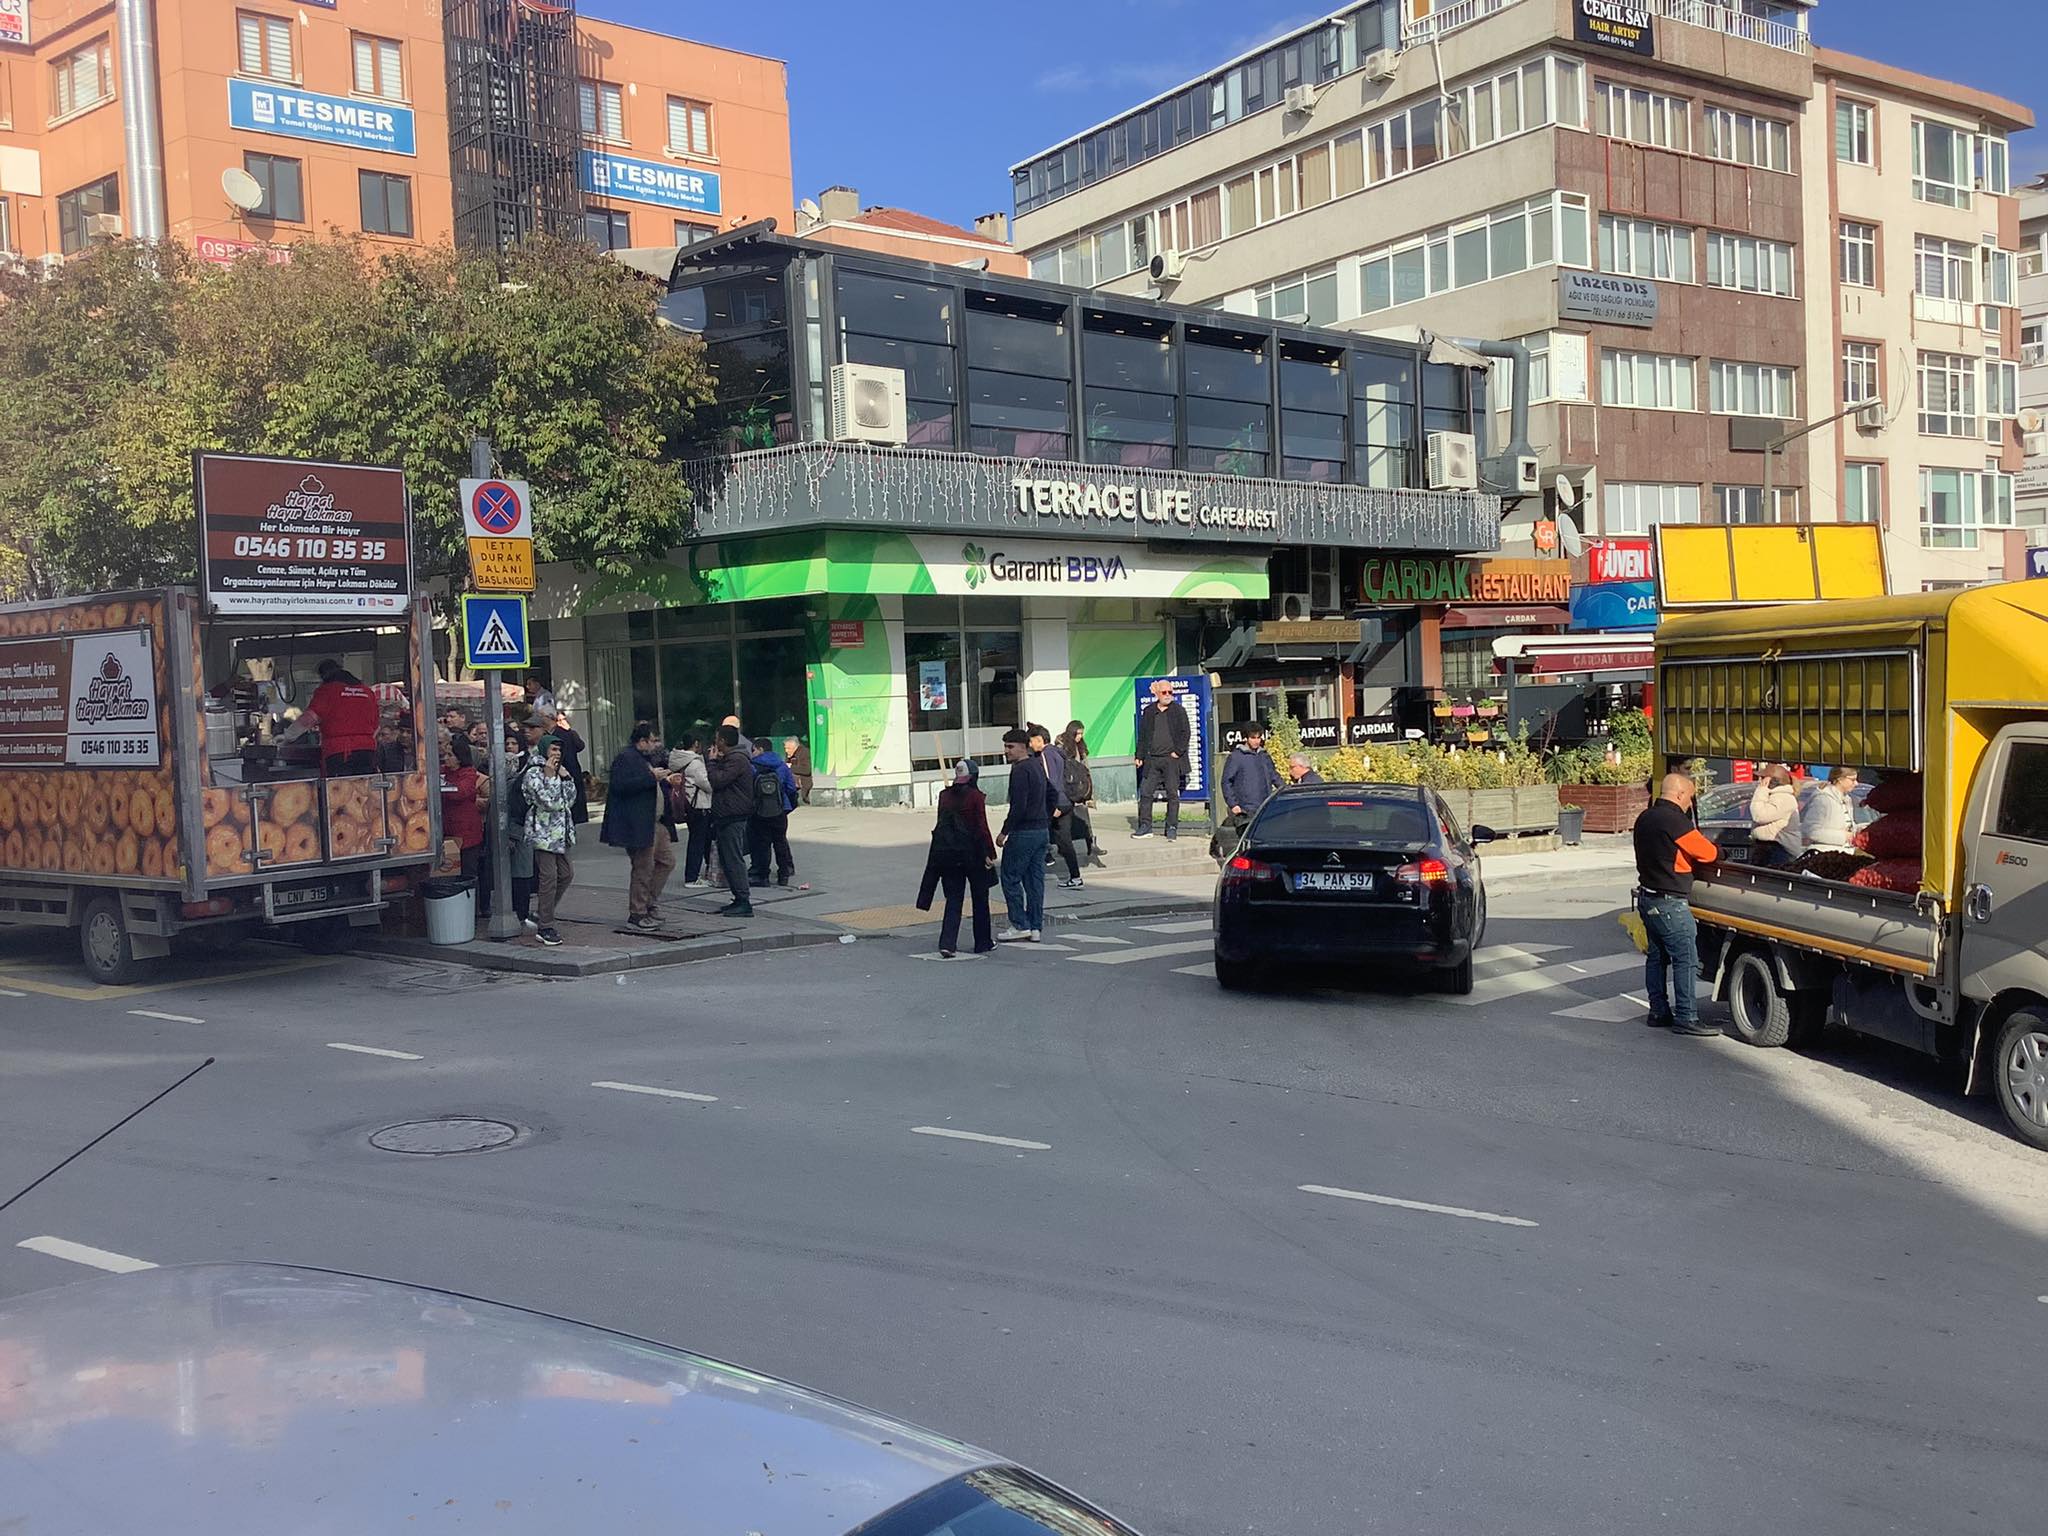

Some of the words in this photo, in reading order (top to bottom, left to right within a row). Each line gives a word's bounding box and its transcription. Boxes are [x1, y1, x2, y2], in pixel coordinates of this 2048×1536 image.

[1626, 8, 1649, 28] SAY
[1590, 19, 1609, 33] HAIR
[1612, 25, 1640, 40] ARTIST
[277, 95, 394, 132] TESMER
[280, 117, 305, 128] Temel
[307, 121, 333, 132] Eğitim
[334, 126, 345, 134] ve
[346, 128, 362, 139] Staj
[364, 131, 394, 142] Merkezi
[612, 161, 705, 194] TESMER
[614, 181, 634, 191] Temel
[666, 191, 679, 200] Staj
[681, 193, 704, 203] Merkezi
[1572, 276, 1620, 292] LAZER
[285, 491, 334, 510] Hayrat
[1014, 479, 1137, 520] TERRACE
[1141, 487, 1192, 523] LIFE
[1200, 505, 1279, 529] CAFE&REST
[267, 504, 302, 522] Hayır
[304, 506, 352, 522] Lokması
[260, 522, 277, 531] Her
[279, 523, 320, 534] Lokmada
[322, 524, 335, 534] Bir
[337, 525, 360, 537] Hayır
[234, 536, 290, 558] 0546
[296, 538, 326, 559] 110
[331, 540, 356, 560] 35
[361, 541, 386, 561] 35
[481, 553, 521, 562] DURAK
[257, 565, 286, 575] Cenaze,
[288, 565, 316, 576] Sünnet,
[318, 566, 338, 578] Açılış
[350, 566, 366, 576] Tüm
[486, 564, 521, 573] ALANI
[990, 552, 1061, 582] Garanti
[1066, 555, 1127, 582] BBVA
[316, 578, 336, 589] Hayır
[478, 575, 532, 585] BAŞLANGICI
[1363, 558, 1471, 602] ÇARDAK
[1471, 573, 1571, 601] RESTAURANT
[1505, 614, 1536, 624] ÇARDAK
[1573, 654, 1614, 668] ÇARDAK
[89, 677, 131, 704] Hayrat
[77, 698, 105, 724] Hayır
[105, 699, 148, 719] Lokması
[1299, 726, 1336, 740] ARDAK
[1352, 722, 1394, 738] ÇARDAK
[81, 740, 104, 754] 0546
[106, 740, 120, 754] 110
[123, 740, 134, 754] 35
[136, 740, 149, 754] 35
[1302, 873, 1316, 885] 34
[1323, 873, 1345, 885] PAK
[1350, 873, 1371, 886] 597
